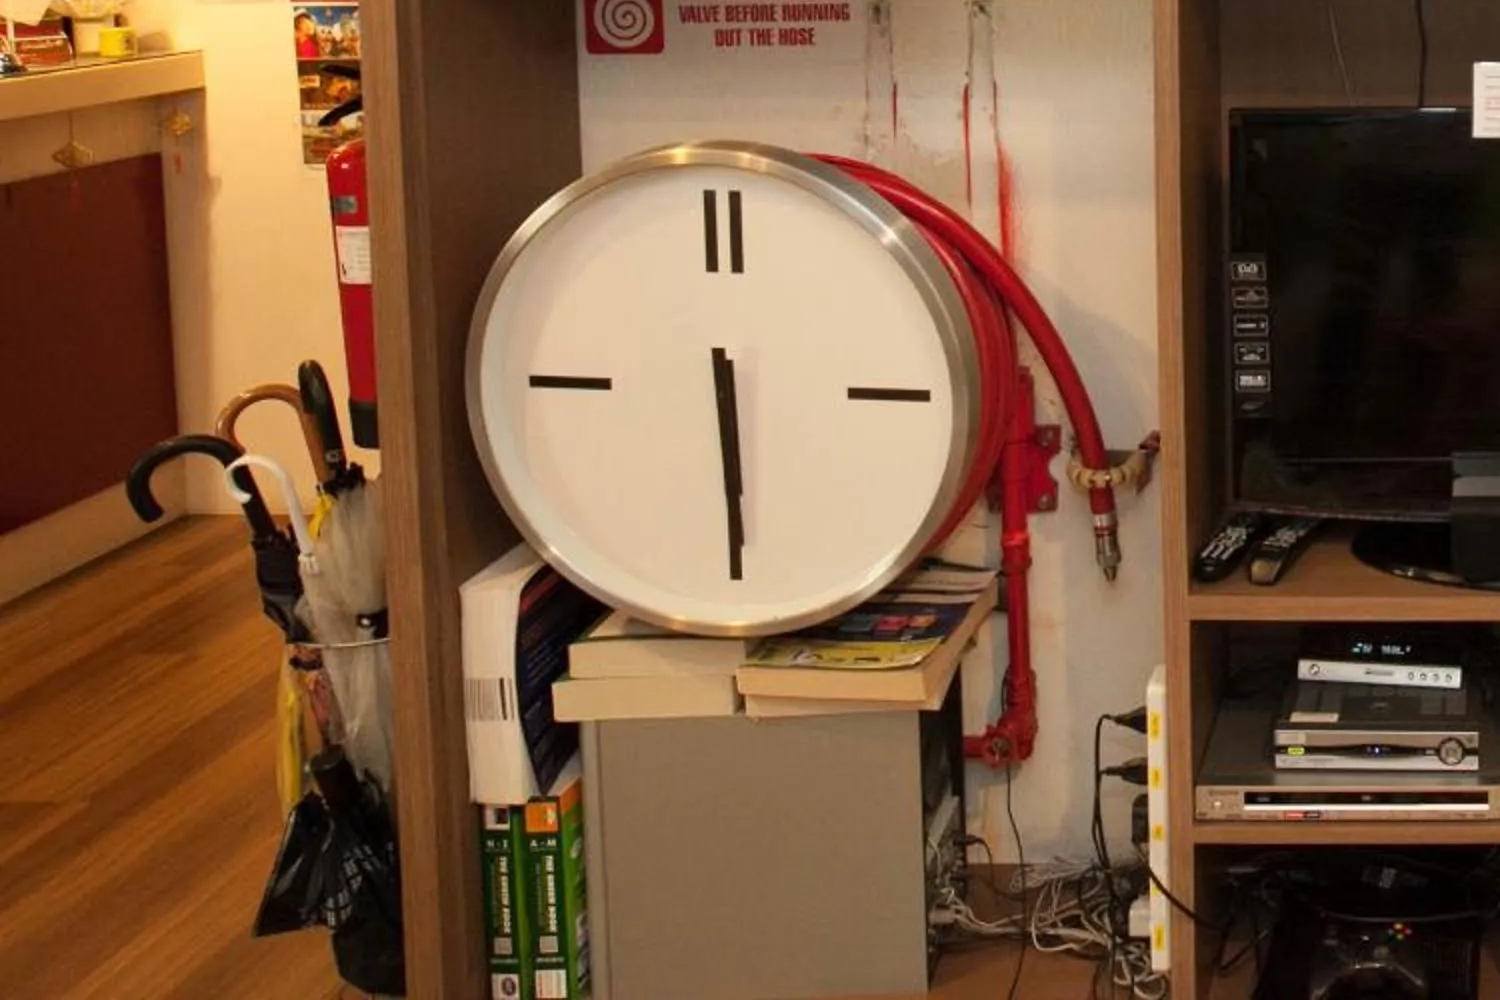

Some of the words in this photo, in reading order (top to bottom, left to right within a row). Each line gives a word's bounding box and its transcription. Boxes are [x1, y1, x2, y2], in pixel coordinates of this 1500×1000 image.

[679, 5, 721, 24] VALVE
[725, 4, 777, 22] BEFORE
[782, 3, 851, 22] RUNNING
[714, 29, 742, 47] OUT
[747, 28, 775, 47] THE
[778, 27, 816, 46] HOSE
